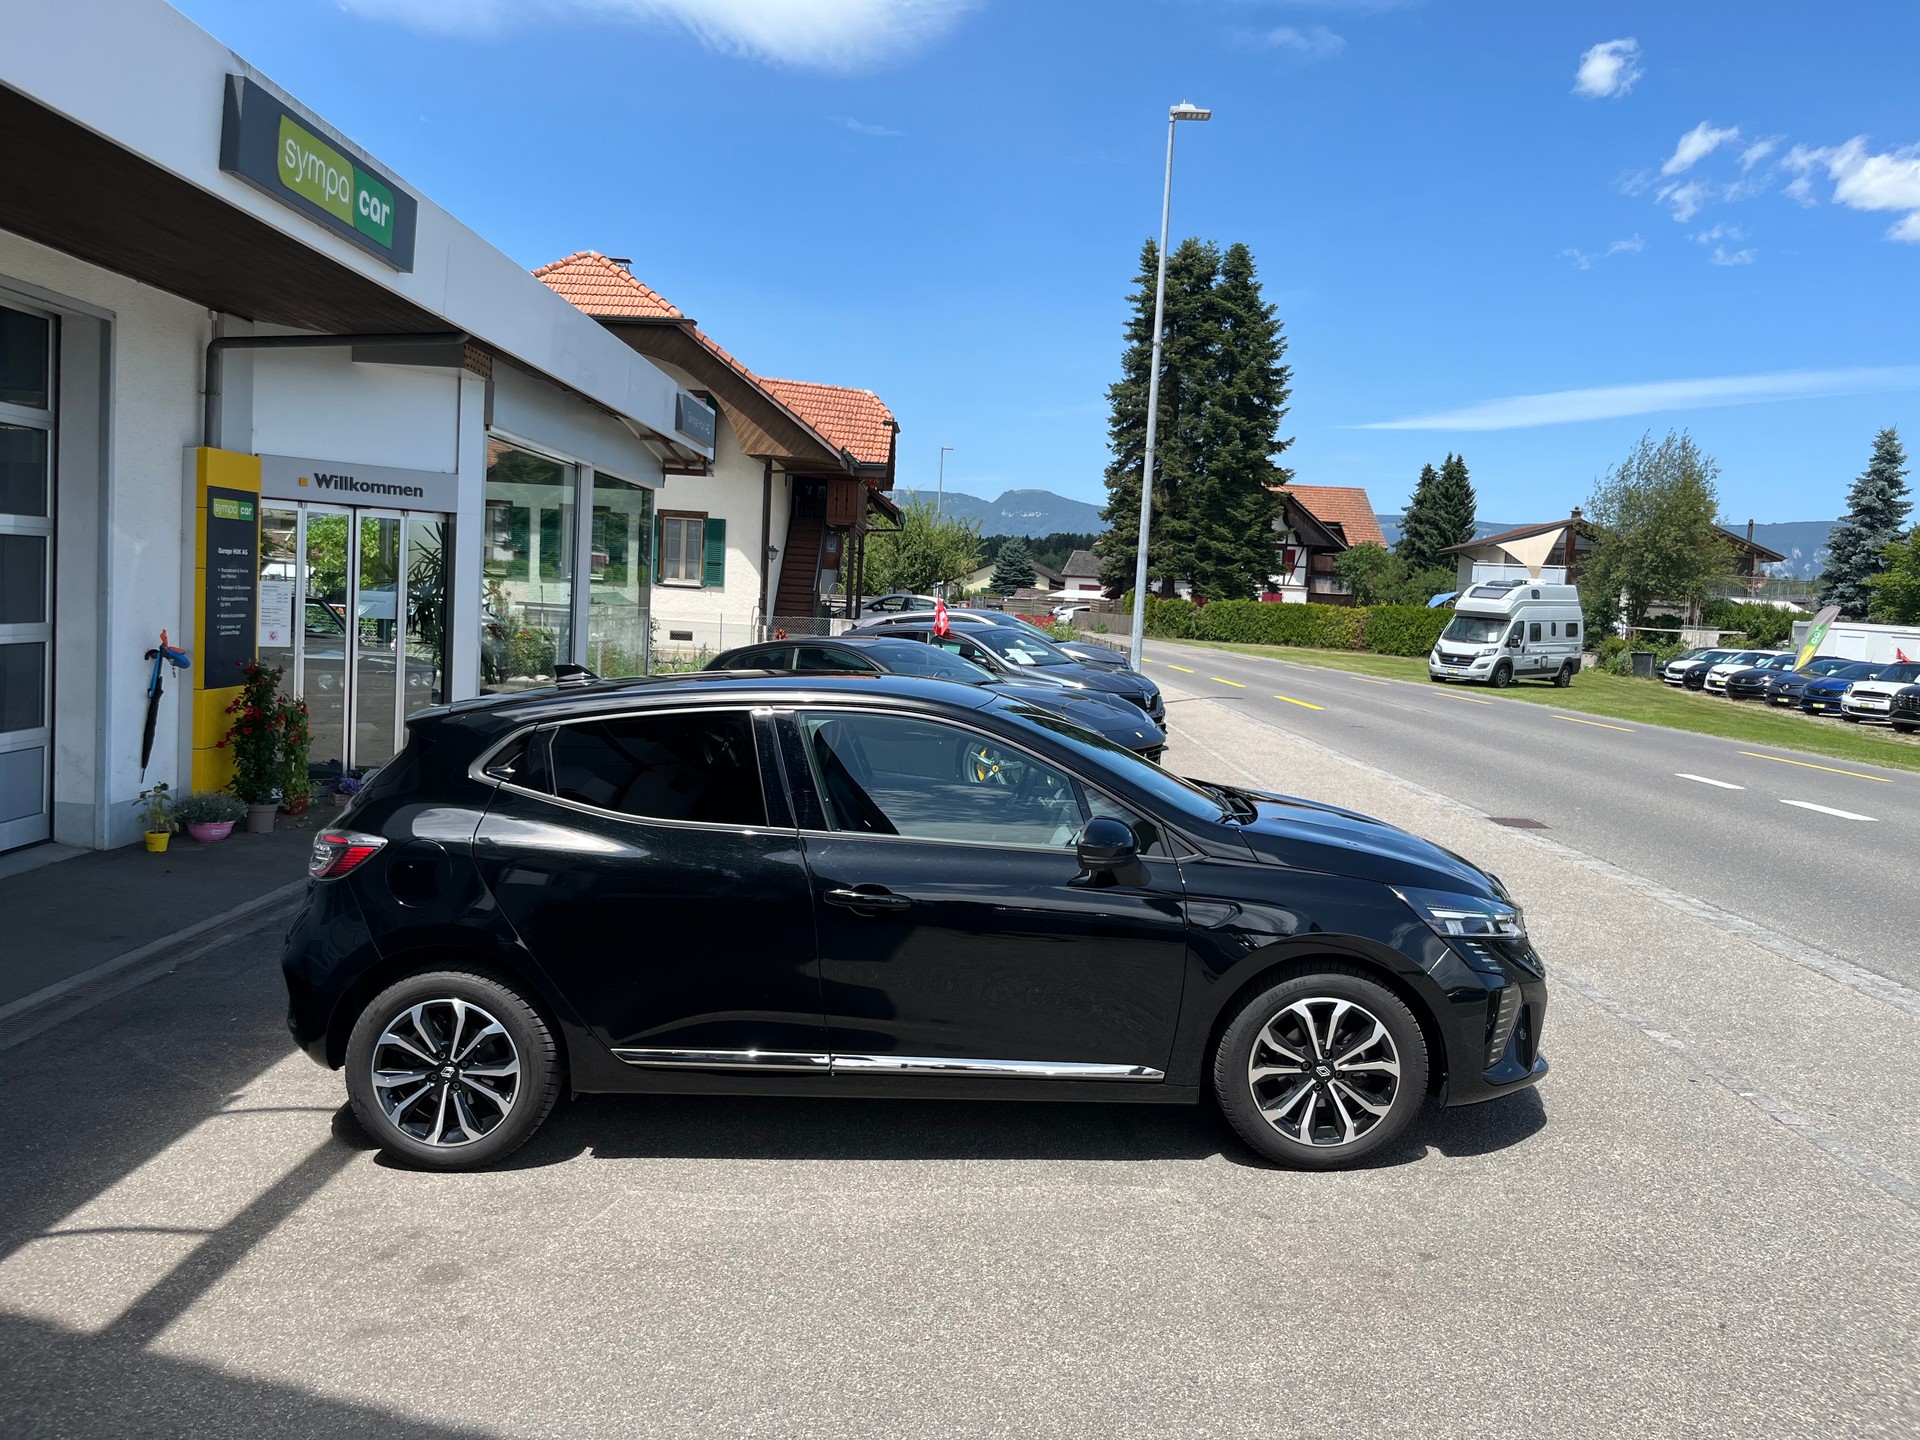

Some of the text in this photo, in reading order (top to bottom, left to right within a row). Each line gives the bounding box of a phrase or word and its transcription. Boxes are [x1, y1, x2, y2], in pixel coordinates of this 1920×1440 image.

[285, 139, 390, 227] sympa car
[314, 473, 424, 498] Willkommen
[215, 503, 252, 516] sympa car
[218, 547, 232, 556] Garage
